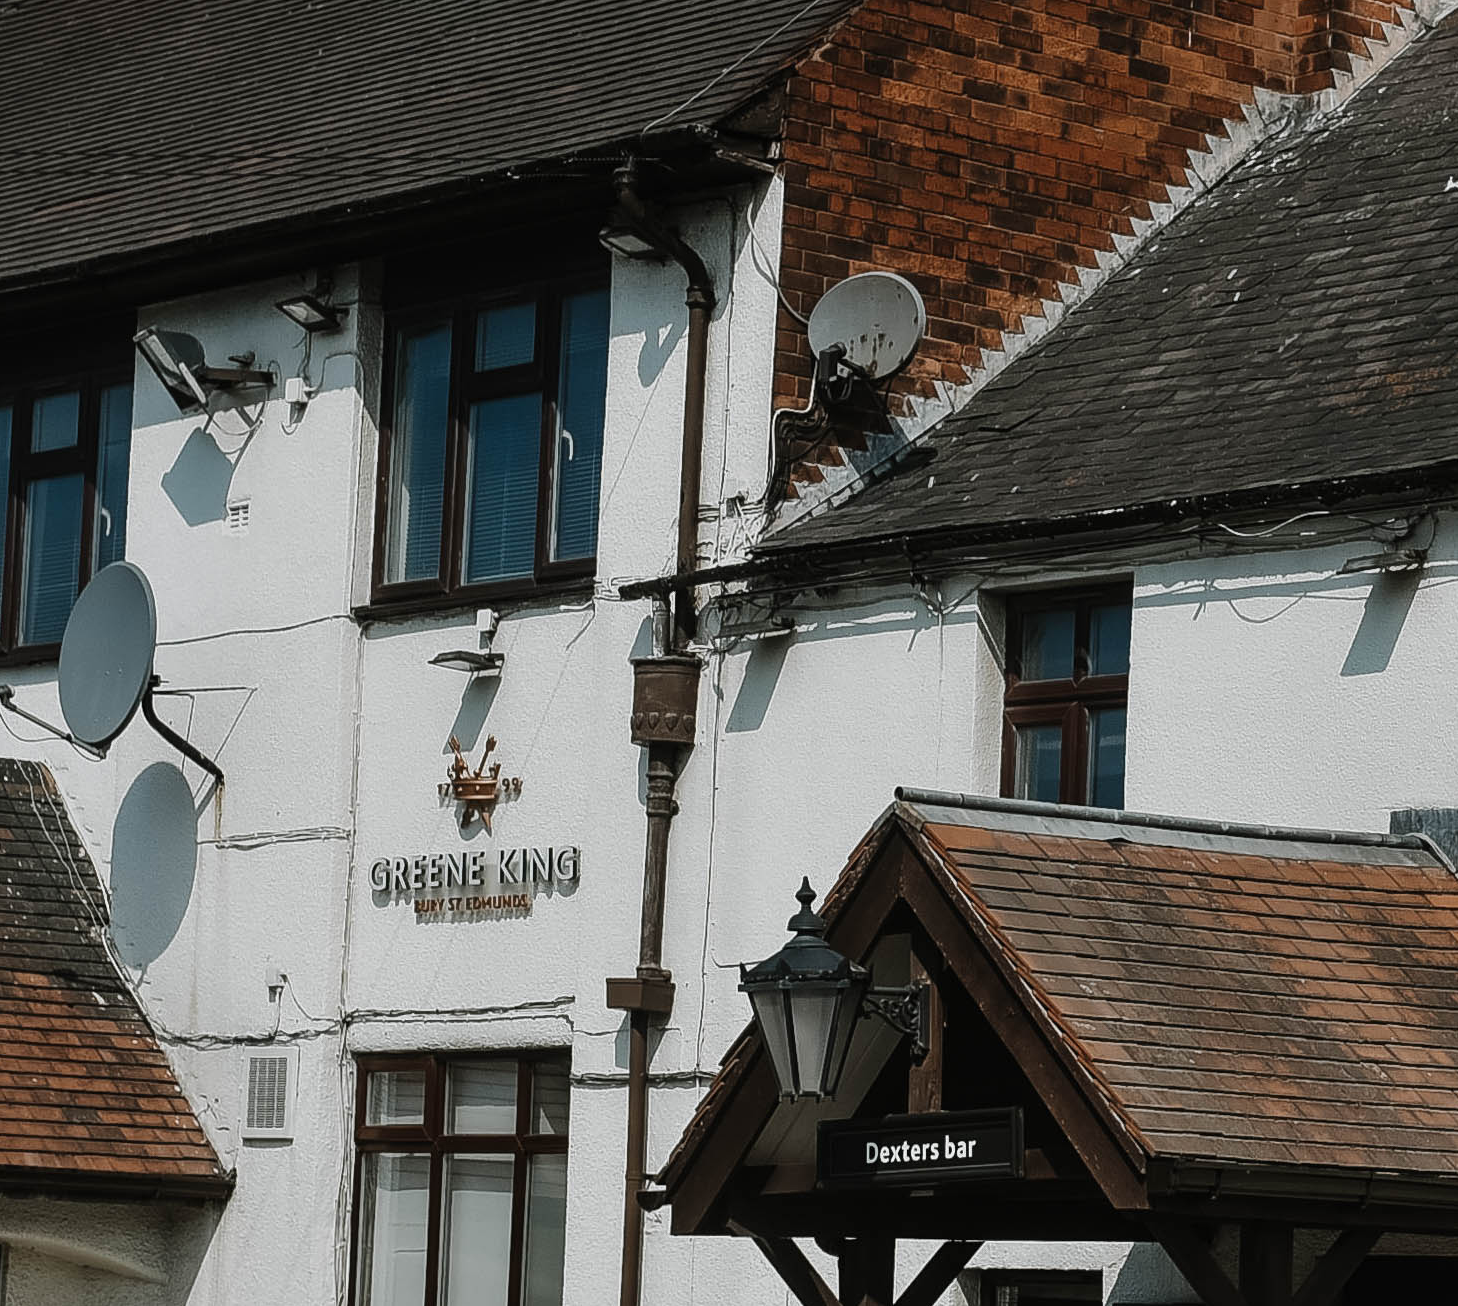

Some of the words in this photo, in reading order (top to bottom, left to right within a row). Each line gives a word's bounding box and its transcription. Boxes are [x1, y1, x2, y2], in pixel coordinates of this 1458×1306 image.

[368, 851, 486, 892] GREENE
[497, 846, 578, 885] KING
[414, 897, 443, 914] BURY
[447, 897, 463, 912] ST
[465, 894, 529, 912] EDMUNDS
[865, 1140, 940, 1164] Dexters
[944, 1134, 977, 1159] bar
